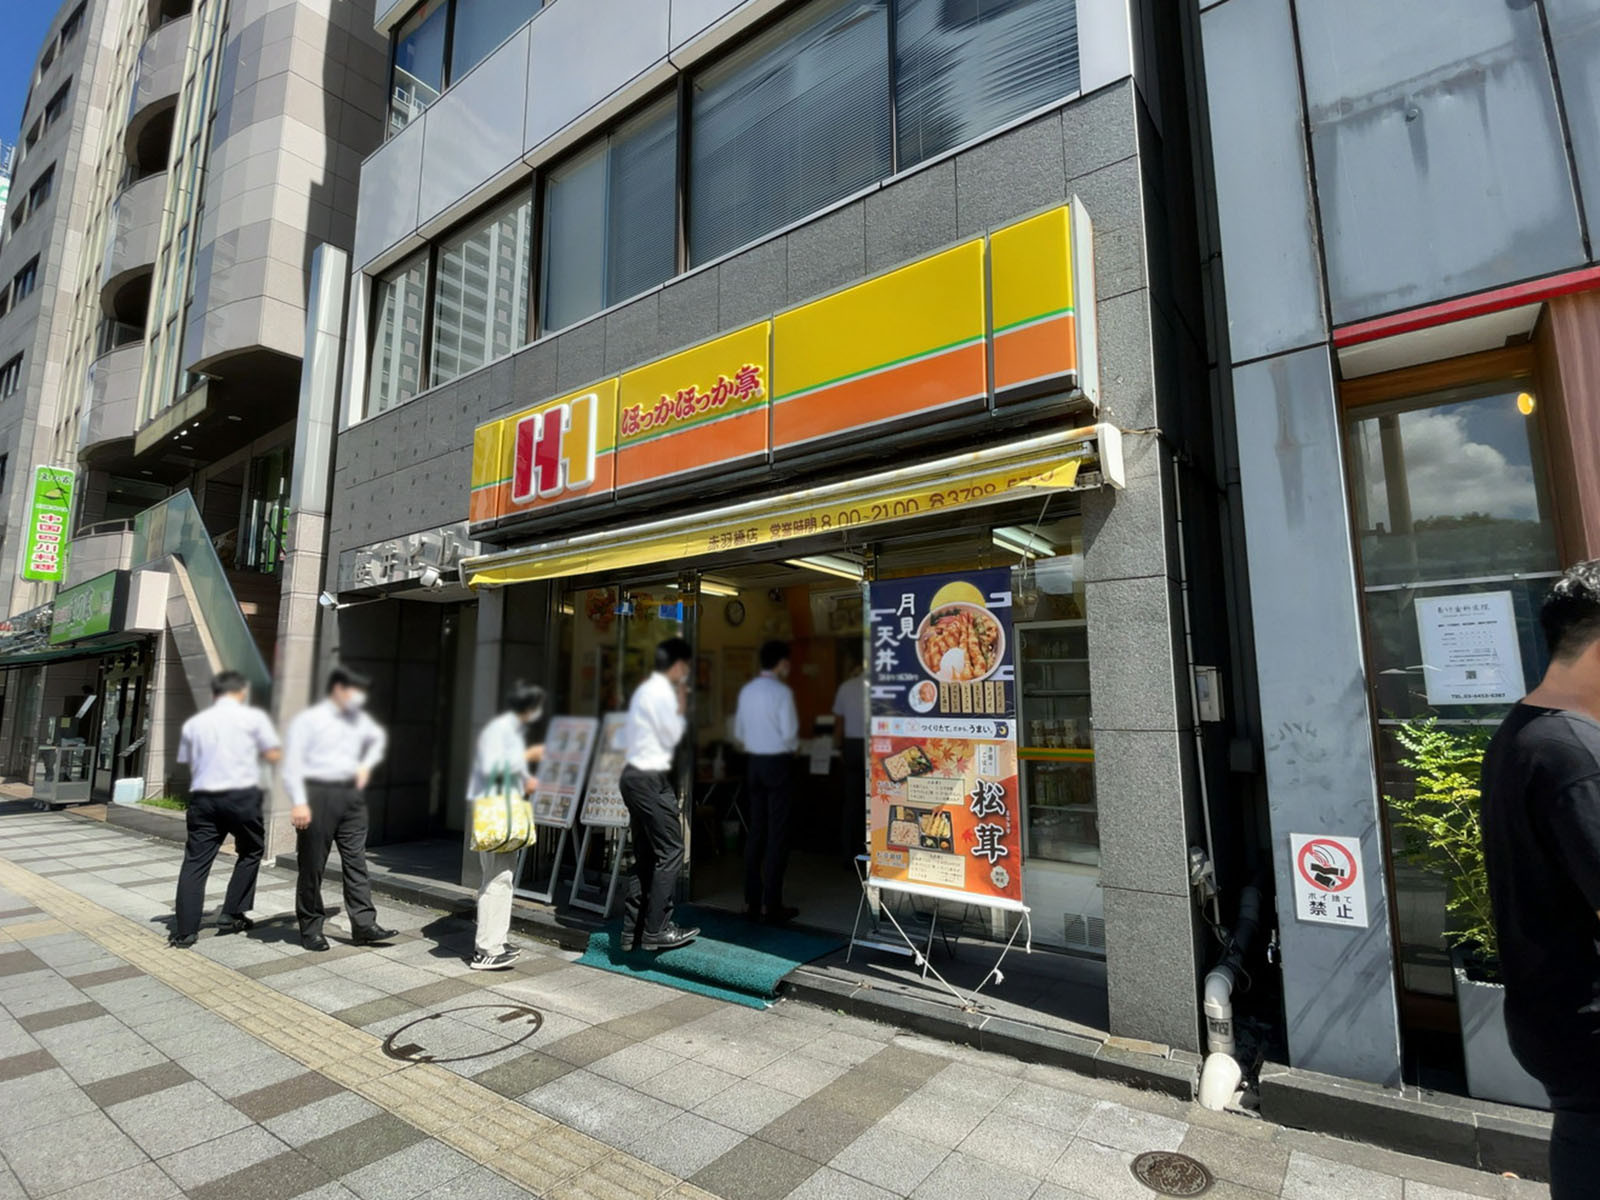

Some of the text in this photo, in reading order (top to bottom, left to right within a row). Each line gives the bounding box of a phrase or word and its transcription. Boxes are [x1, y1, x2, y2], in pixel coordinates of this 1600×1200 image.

[621, 364, 762, 436] ほっかほっか亭
[897, 593, 919, 640] 月見
[874, 626, 900, 672] 天丼
[971, 779, 1008, 864] 松茸
[1308, 892, 1352, 904] ポイ捨て
[1309, 901, 1354, 919] 禁止
